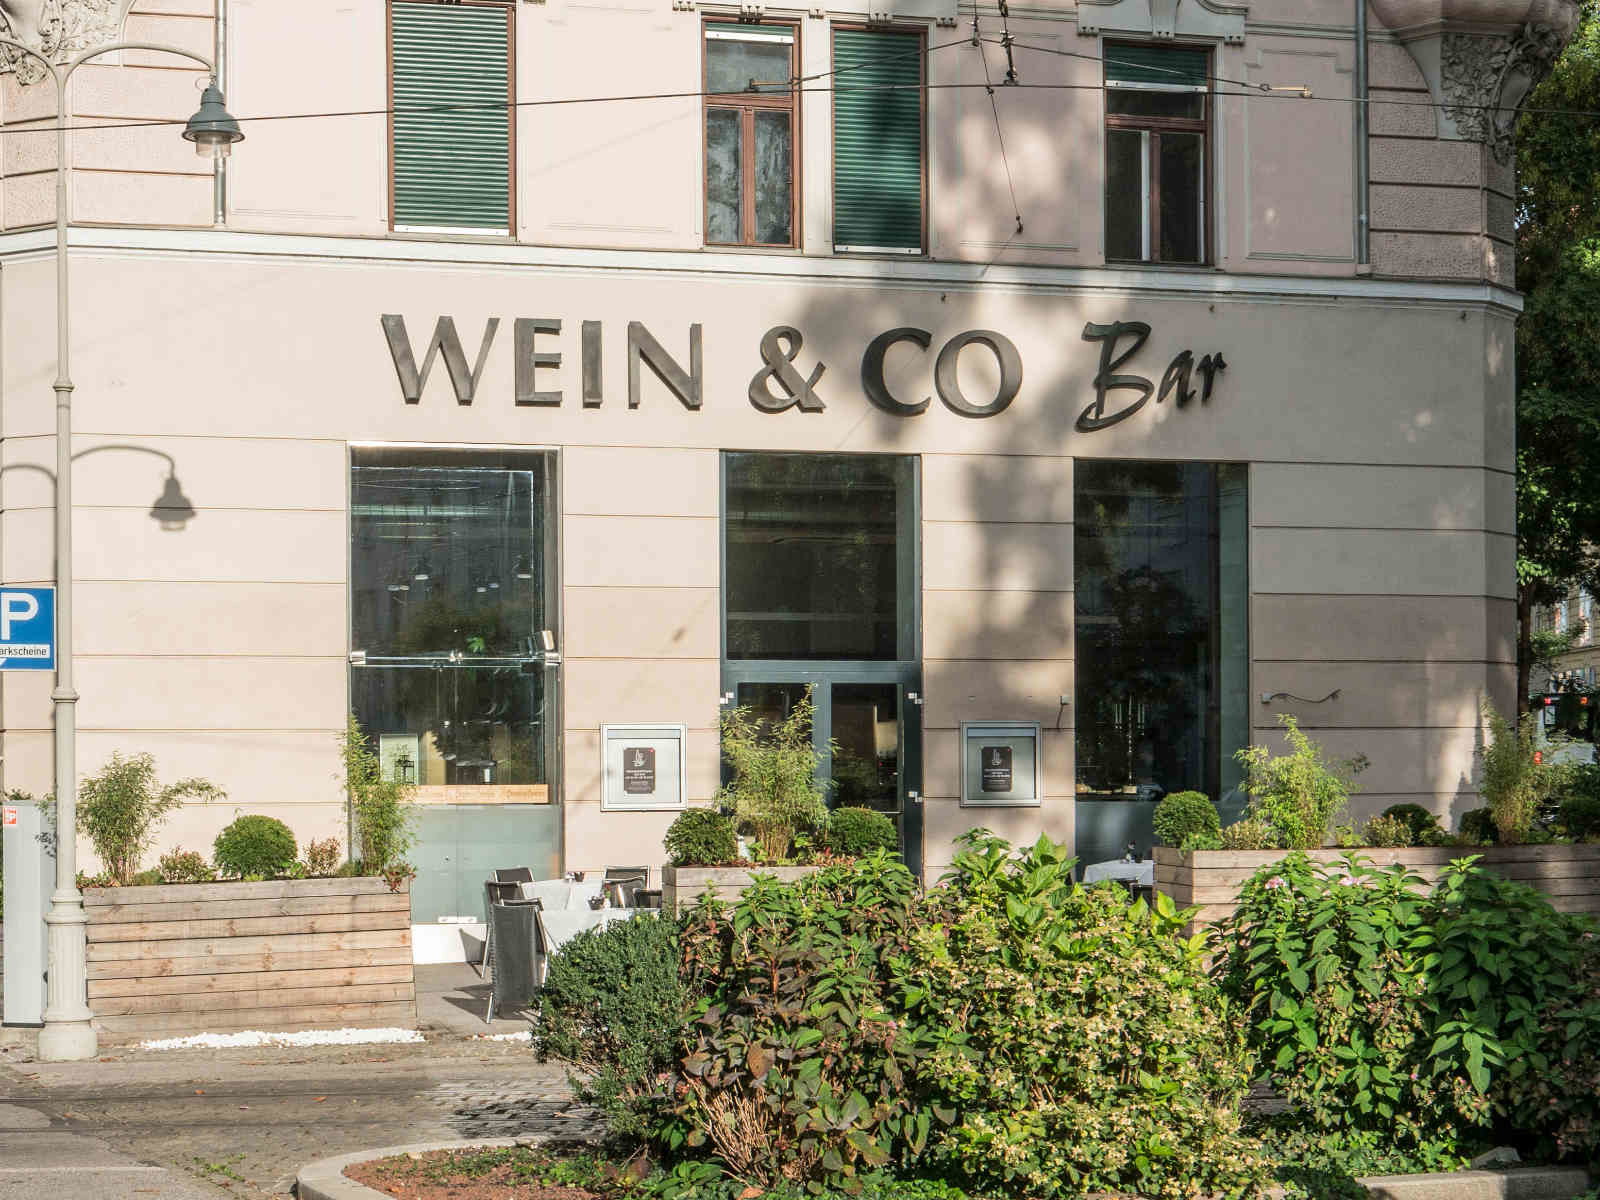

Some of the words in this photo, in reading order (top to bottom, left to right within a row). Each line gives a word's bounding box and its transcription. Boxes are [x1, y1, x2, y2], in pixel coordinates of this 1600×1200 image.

[381, 313, 703, 412] WEIN
[748, 325, 827, 415] &
[861, 326, 1023, 419] CO
[1074, 319, 1228, 433] Bar
[1, 592, 39, 641] P
